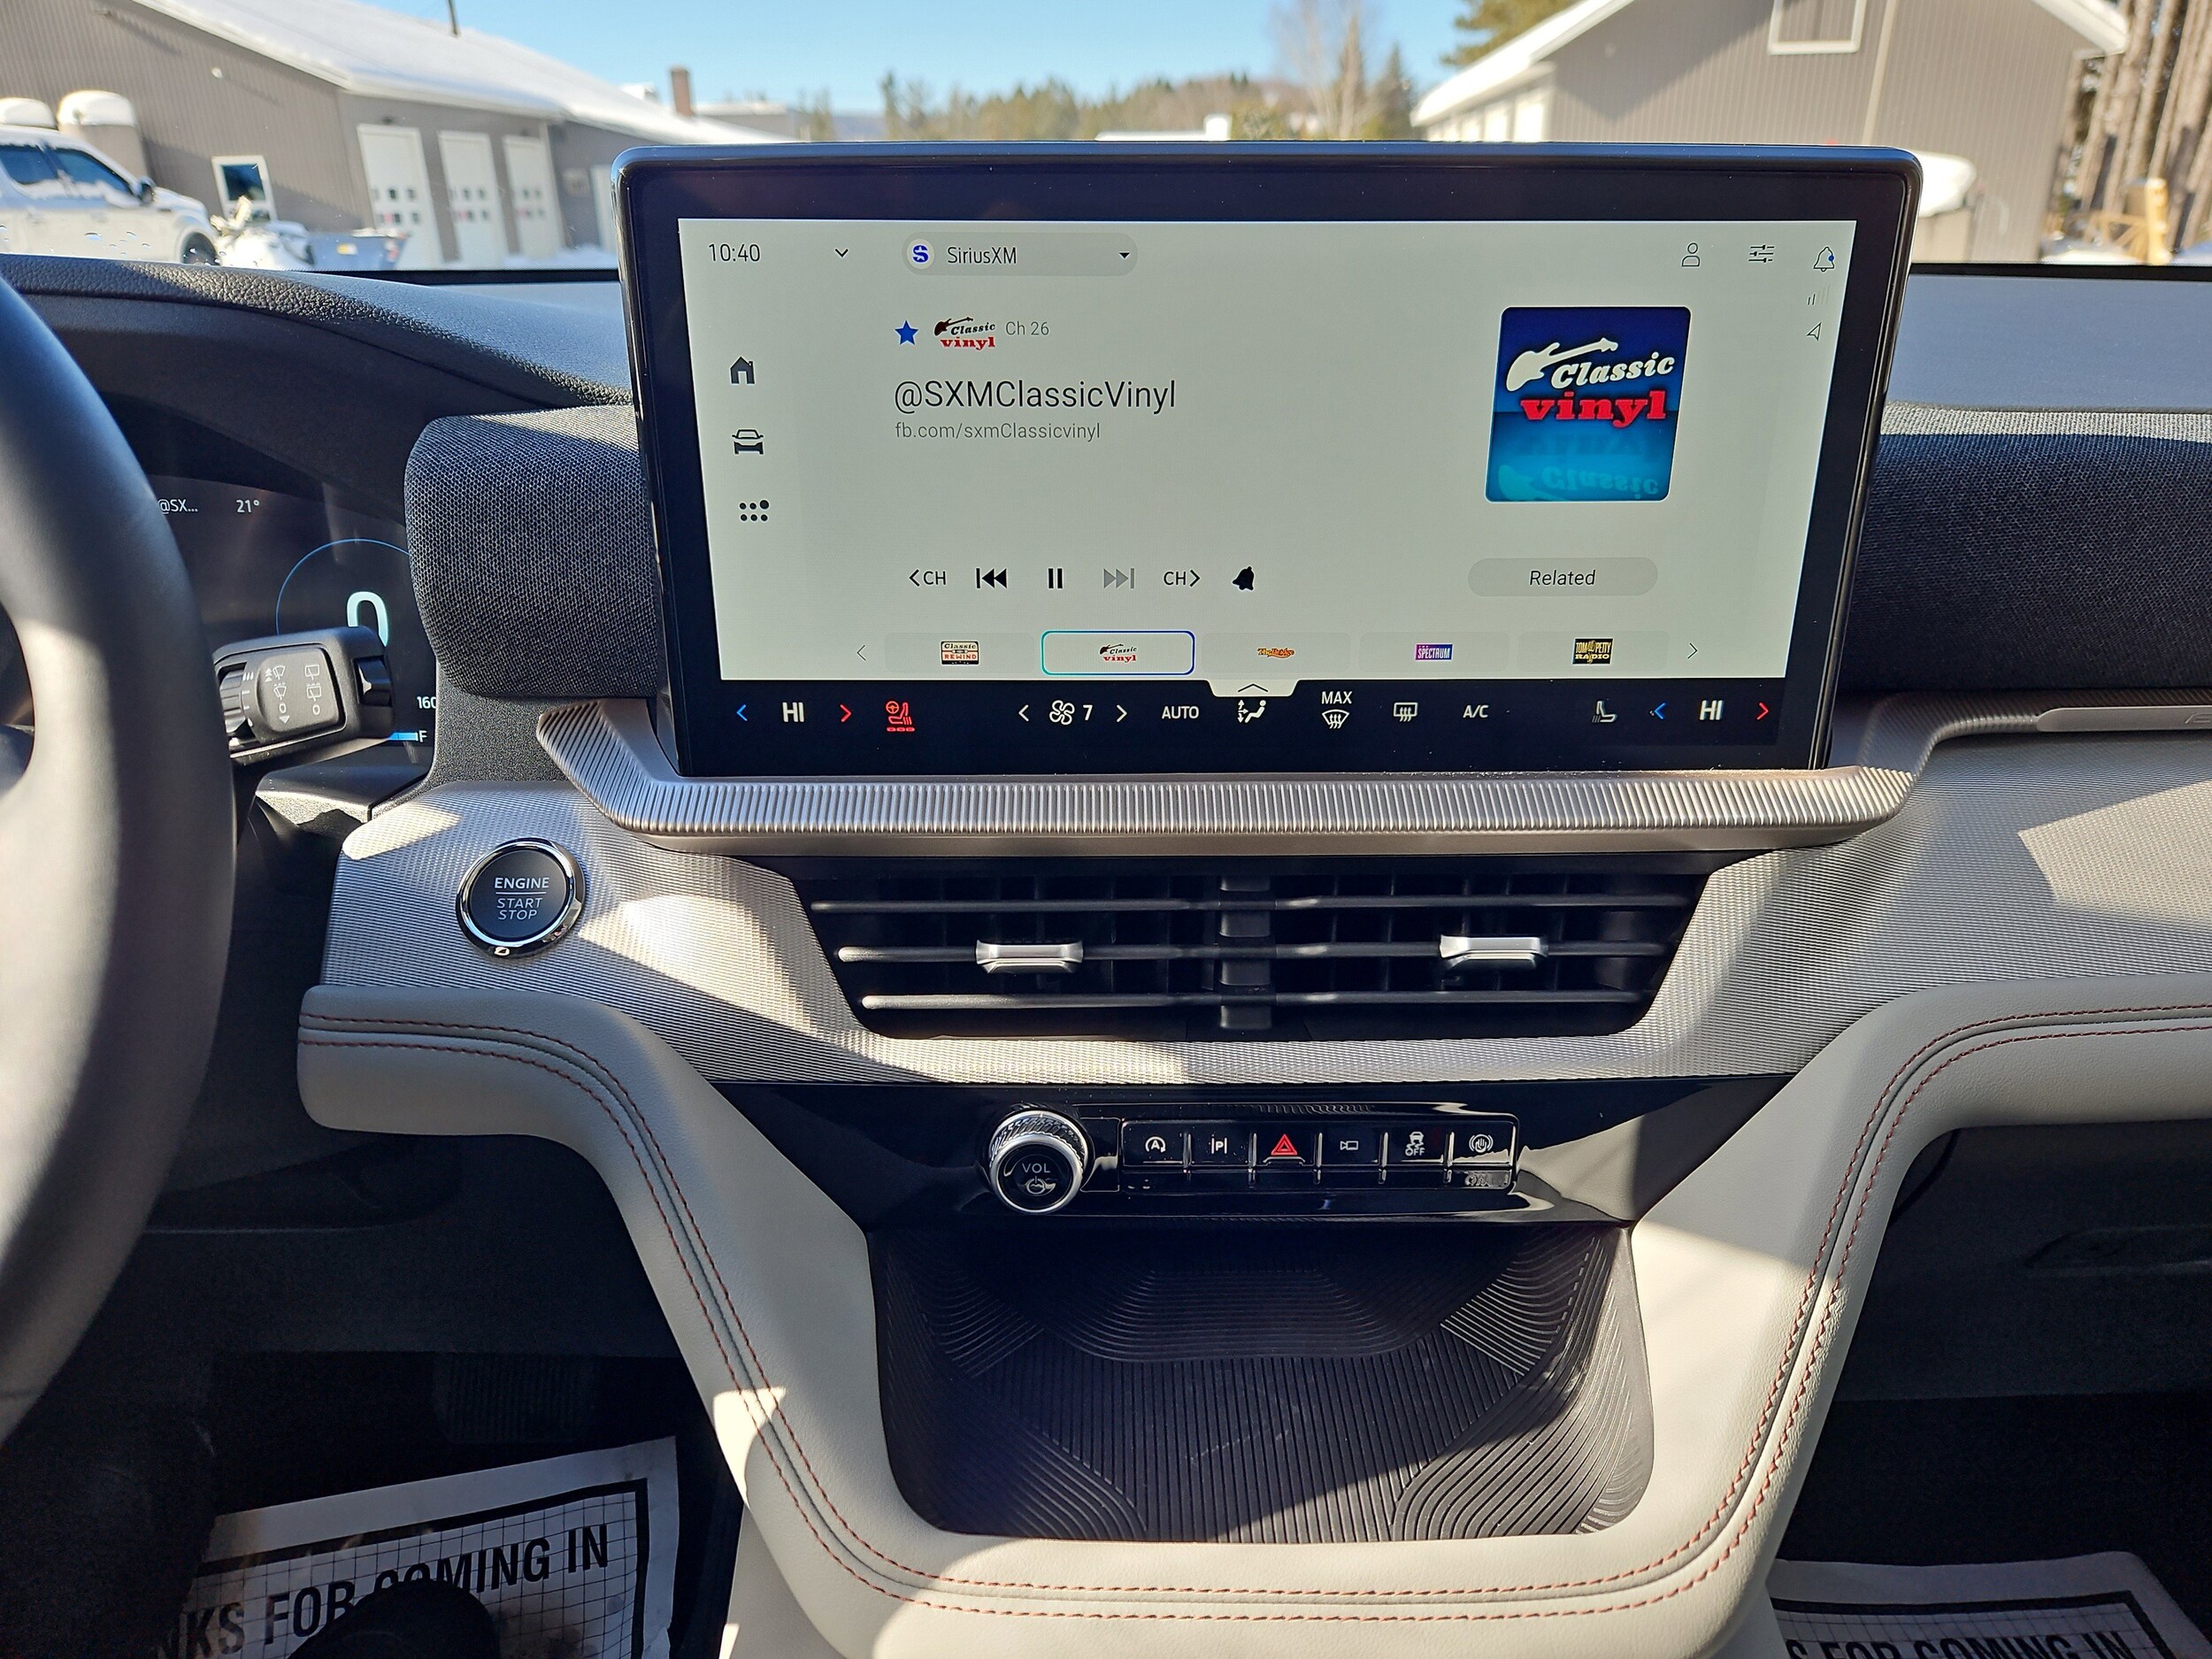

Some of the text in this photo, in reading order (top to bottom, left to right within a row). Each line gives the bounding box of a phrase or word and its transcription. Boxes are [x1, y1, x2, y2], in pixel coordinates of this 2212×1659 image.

[708, 242, 761, 263] 10:40
[947, 246, 1017, 265] SiriusXM
[950, 321, 996, 336] Classic
[1005, 320, 1049, 336] Ch 26
[940, 336, 996, 351] vinyl
[1551, 351, 1675, 389] Classic
[895, 379, 1175, 415] @SXMClassicVinyl
[1520, 390, 1667, 428] vinyl
[895, 421, 1101, 443] fb.com/sxmClassicvinyl
[1529, 569, 1596, 587] Related
[1321, 691, 1353, 705] MAX
[782, 702, 804, 723] HI
[1083, 705, 1094, 722] 7
[1162, 705, 1200, 720] AUTO
[1463, 703, 1489, 720] A/C
[1699, 700, 1724, 721] HI
[494, 877, 550, 889] ENGINE
[496, 897, 543, 909] START
[497, 910, 538, 920] STOP
[1404, 1147, 1426, 1156] OFF
[1022, 1163, 1051, 1174] VOL
[567, 1525, 608, 1574] IN
